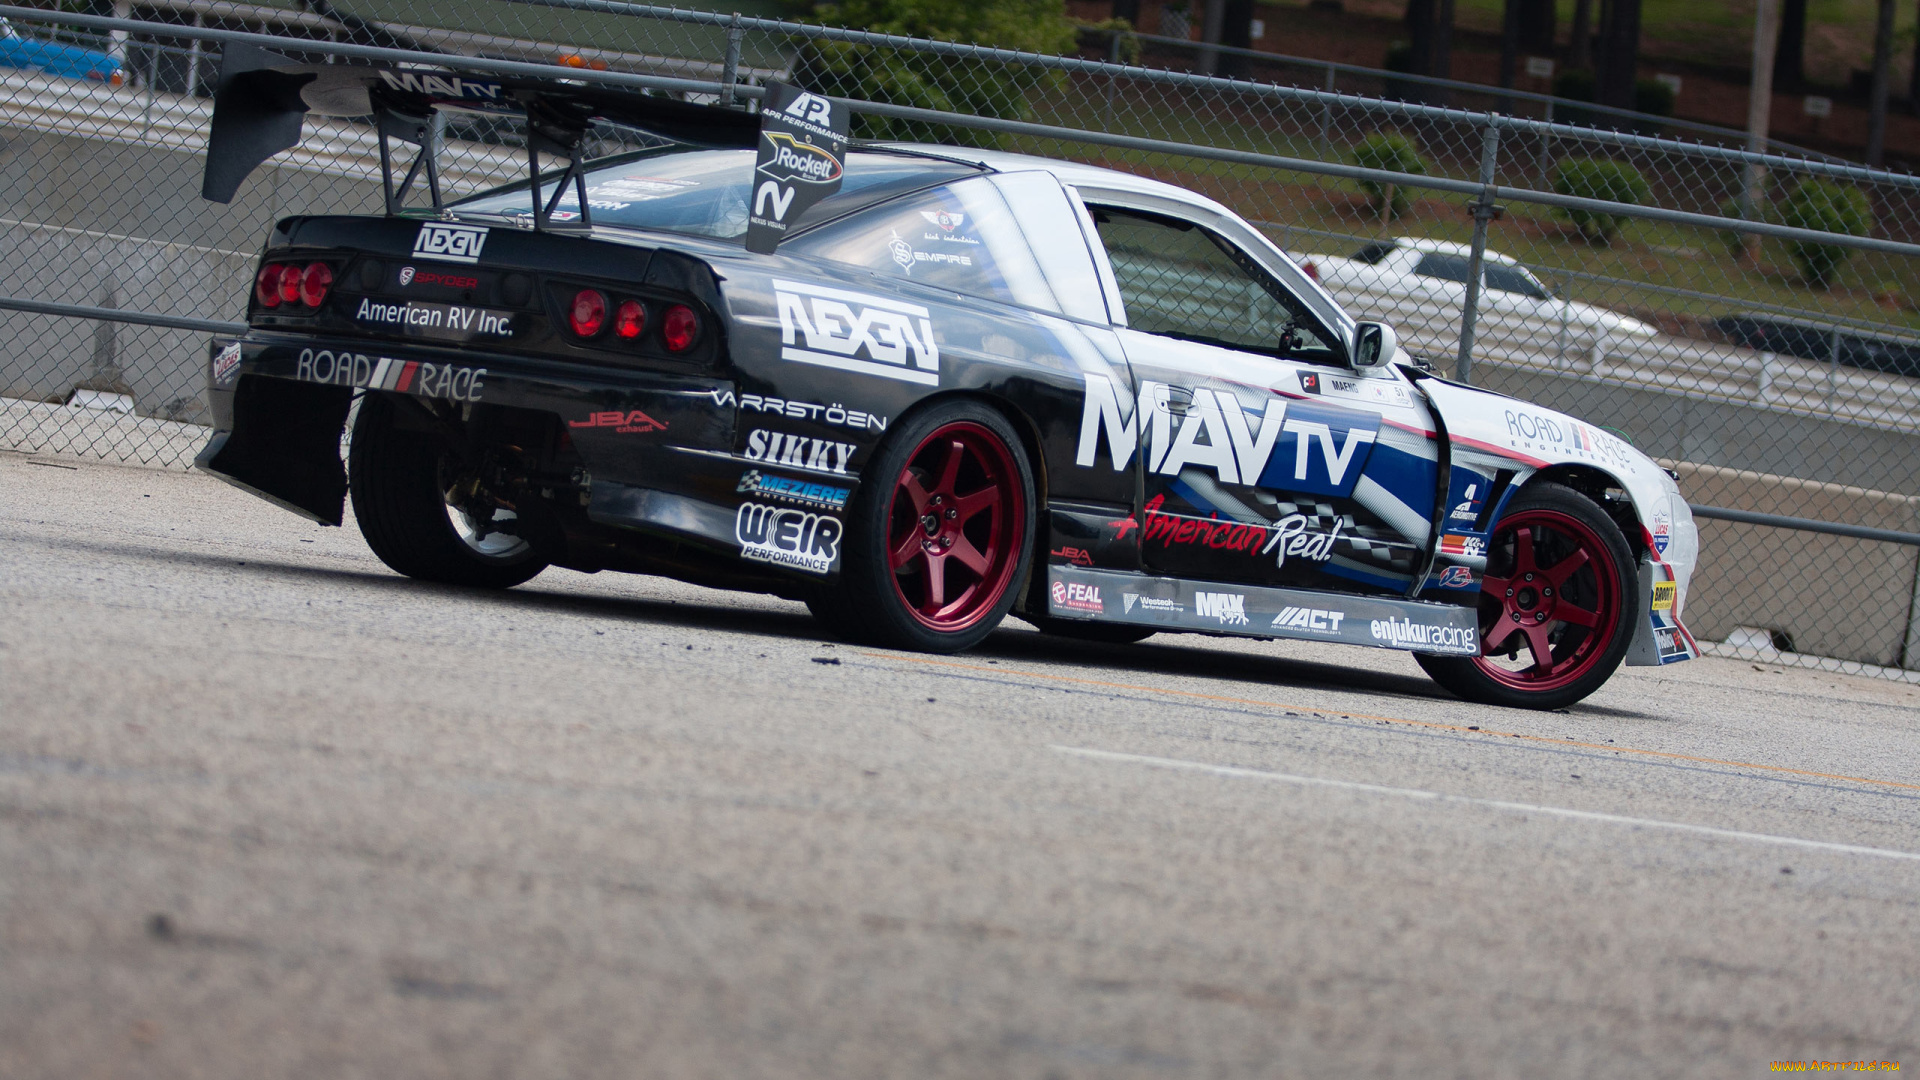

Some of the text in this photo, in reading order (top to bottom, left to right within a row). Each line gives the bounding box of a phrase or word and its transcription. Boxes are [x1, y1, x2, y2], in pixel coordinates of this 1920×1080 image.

[762, 108, 849, 144] APR PERFORMANCE
[778, 146, 832, 178] Rockett
[413, 227, 488, 258] NEXEN
[913, 251, 972, 266] EMPIRE
[413, 272, 478, 289] SPYDER
[356, 298, 513, 336] American RV Inc.
[775, 287, 940, 376] NEXEN
[297, 348, 488, 402] ROAD RACE
[1331, 380, 1359, 394] MAENG
[616, 424, 654, 433] exhaust
[1504, 409, 1631, 464] ROAD RACE
[745, 428, 857, 475] SIKKY
[1511, 440, 1636, 474] ENGINEERING
[755, 491, 843, 512] ENTERPRISES
[757, 474, 850, 505] MEZIERE
[738, 503, 841, 559] WEIR
[1108, 493, 1267, 557] American
[743, 545, 827, 571] PERFORMANCE
[1051, 546, 1093, 566] JBA
[1067, 583, 1102, 603] FEAL
[1140, 596, 1174, 607] Westech
[1196, 591, 1245, 617] MAX
